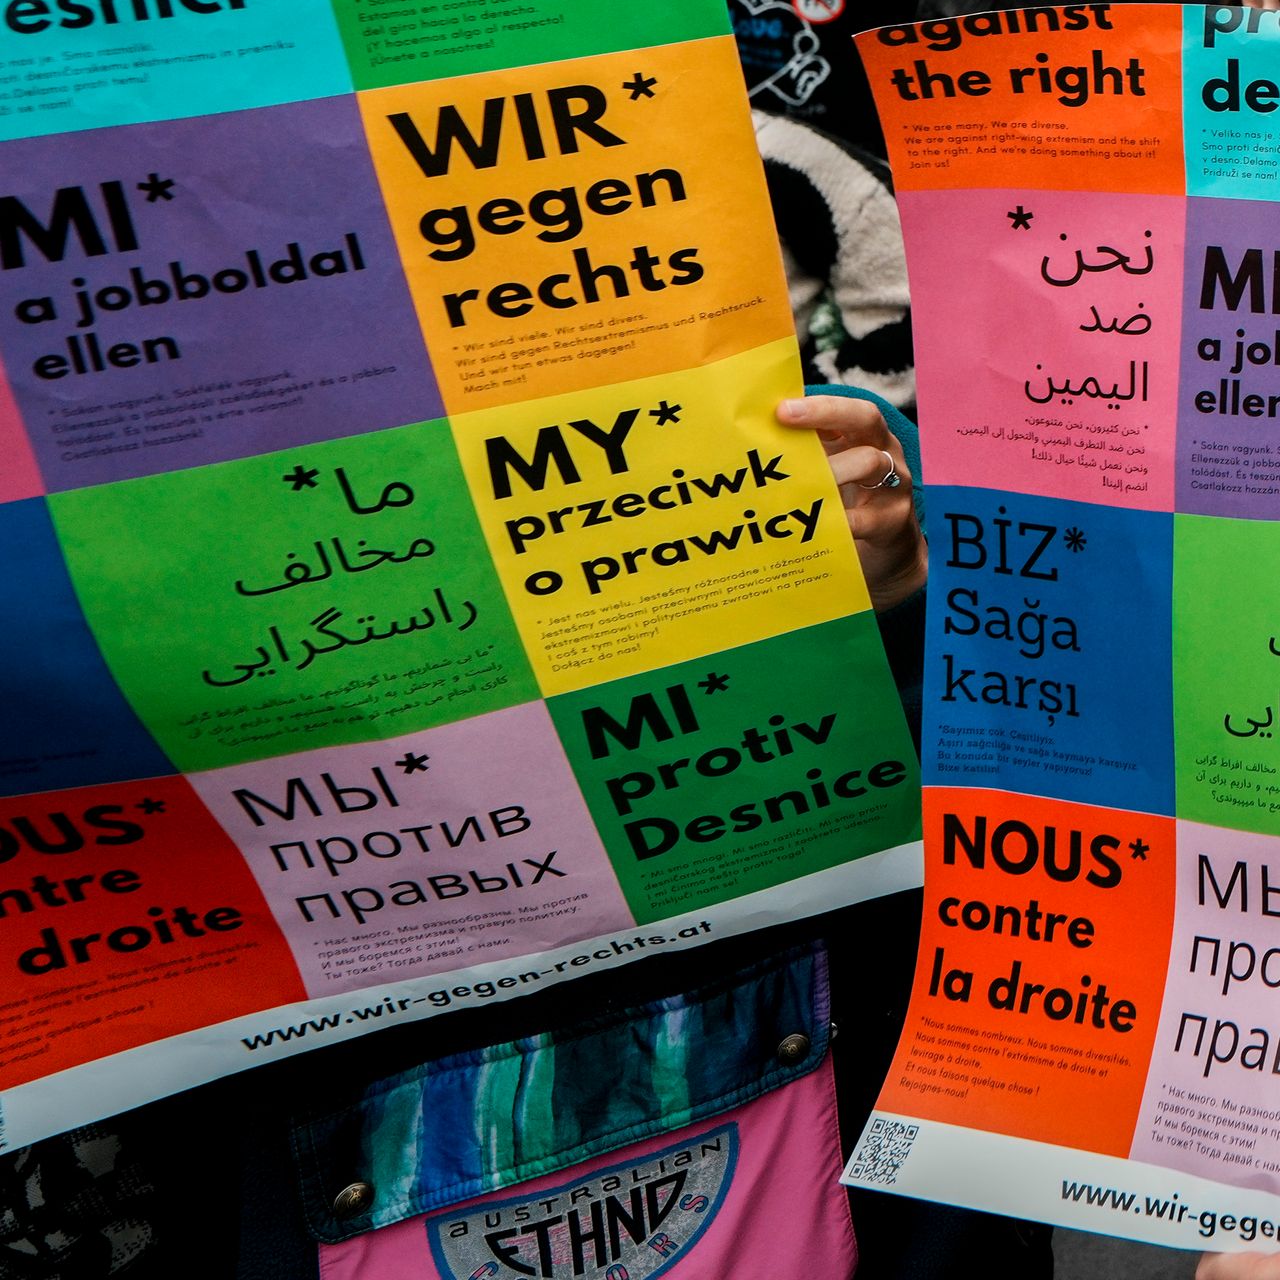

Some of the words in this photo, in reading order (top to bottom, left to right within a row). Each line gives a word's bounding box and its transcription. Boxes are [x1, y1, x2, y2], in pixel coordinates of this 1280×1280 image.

[891, 60, 991, 100] the
[1010, 50, 1145, 107] right
[420, 169, 686, 261] gegen
[443, 246, 704, 327] rechts
[1198, 339, 1220, 361] a
[945, 588, 1080, 659] Sağa
[942, 655, 1079, 727] karşı
[270, 806, 531, 876] против
[295, 851, 566, 925] правых
[938, 897, 1094, 948] contre
[241, 921, 714, 1051] www.wir-gegen-rechts.at
[929, 947, 973, 1002] la
[988, 961, 1136, 1032] droite
